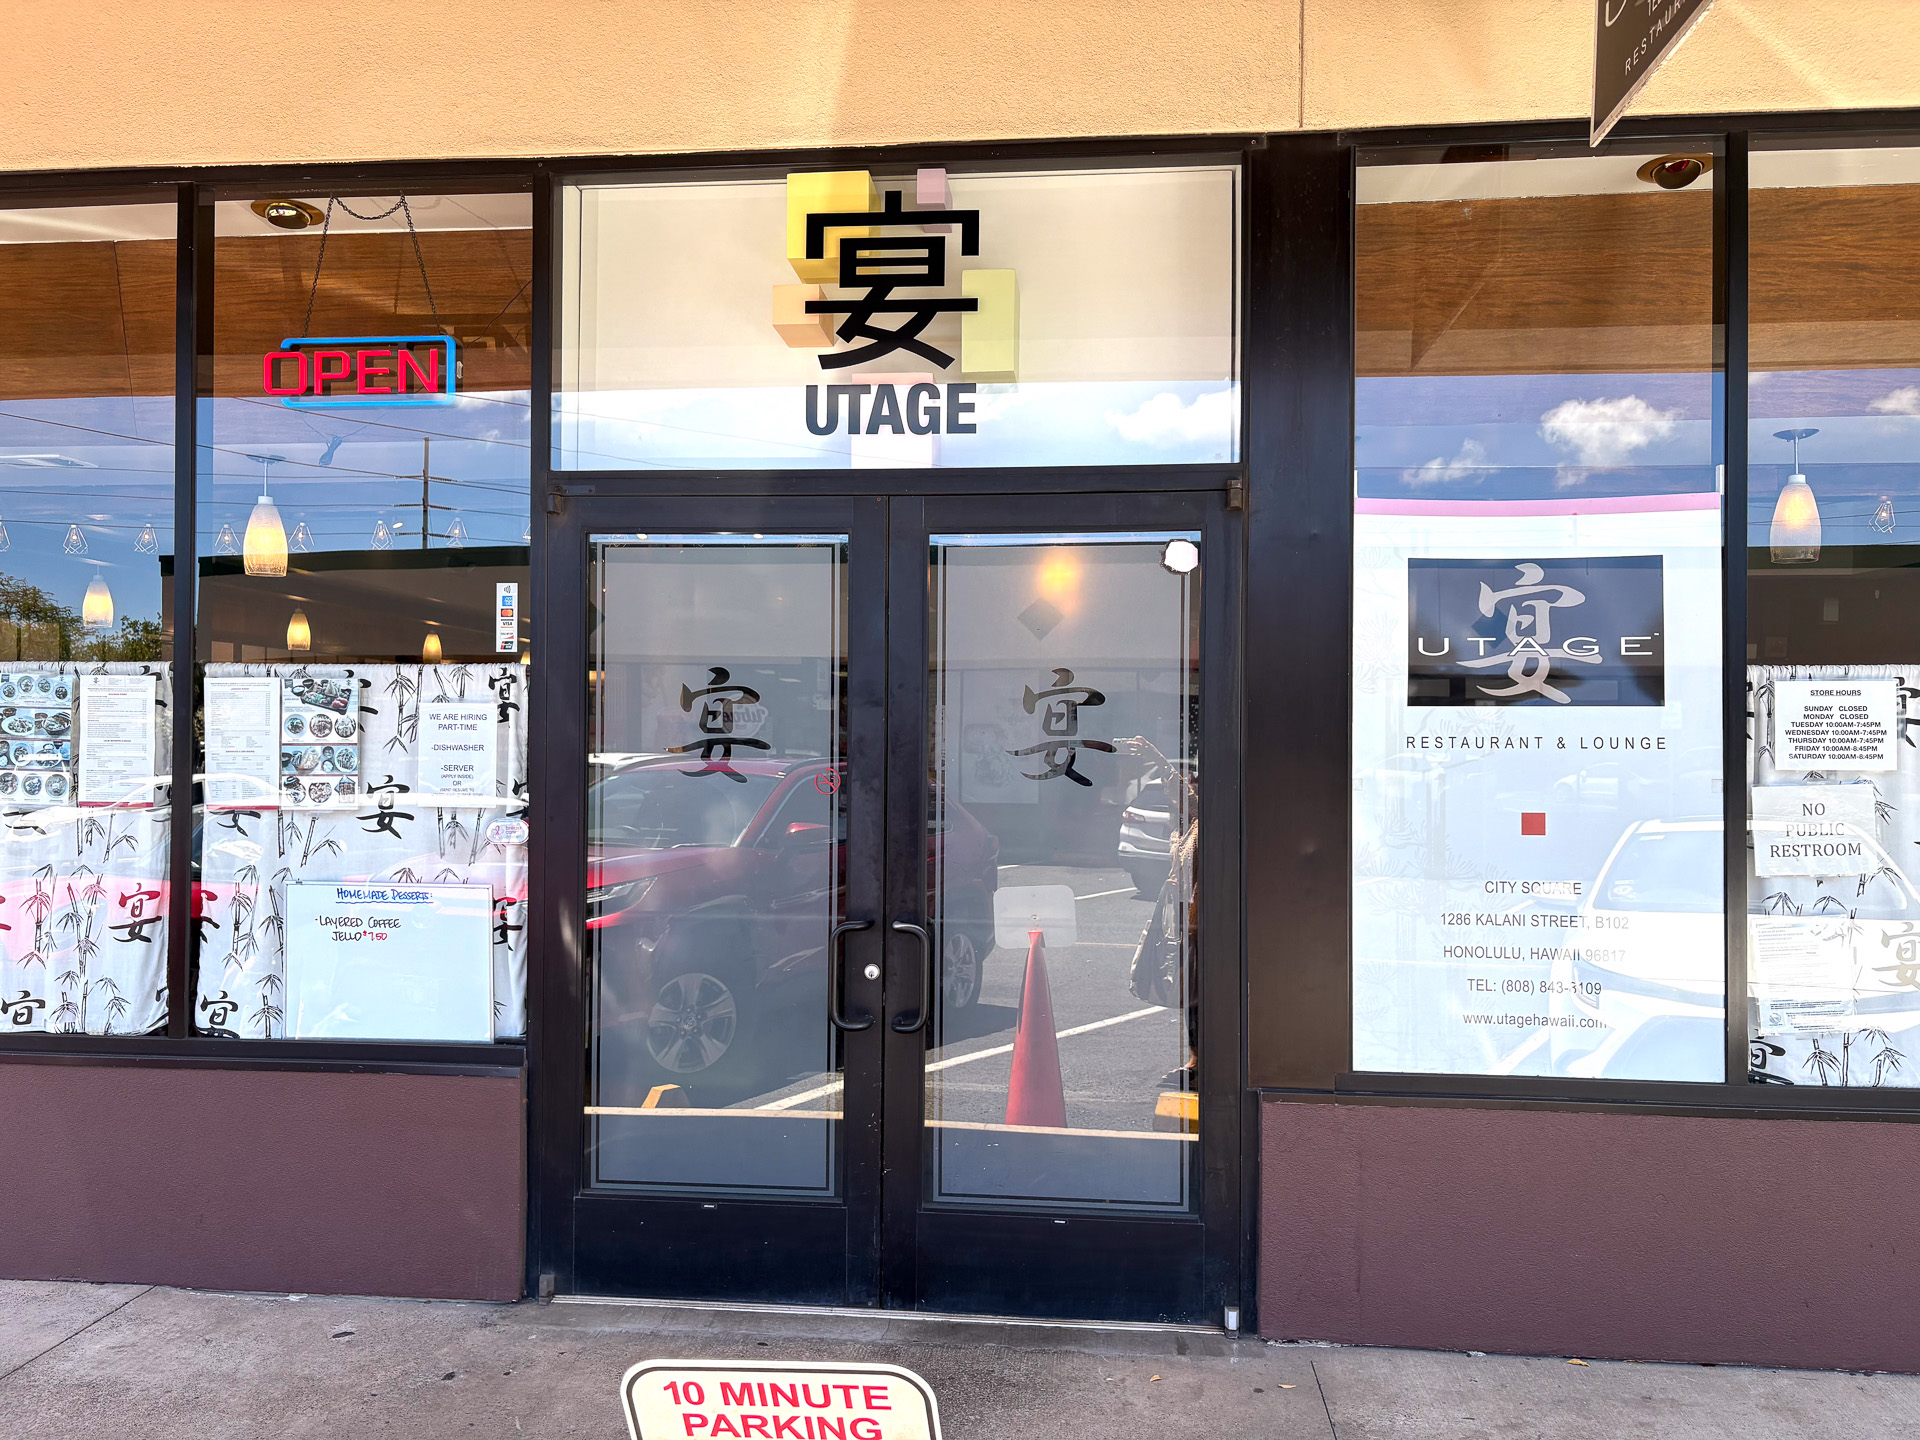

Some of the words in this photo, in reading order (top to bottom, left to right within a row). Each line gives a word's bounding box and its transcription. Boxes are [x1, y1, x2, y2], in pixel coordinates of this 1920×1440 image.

[1625, 0, 1686, 75] RESTAUR
[805, 190, 980, 370] 宴
[263, 349, 438, 396] OPEN
[806, 383, 977, 436] UTAGE
[1456, 562, 1603, 704] 宴
[429, 713, 442, 721] WE
[443, 713, 459, 721] ARE
[460, 713, 488, 721] HIRING
[663, 667, 771, 784] 宴
[1005, 668, 1117, 787] 宴
[431, 744, 485, 752] -DISHWASHER
[1406, 736, 1543, 750] RESTAURANT
[1556, 736, 1567, 750] &
[1580, 736, 1667, 750] LOUNGE
[440, 764, 475, 772] -SERVER
[1802, 802, 1826, 816] NO
[1785, 822, 1845, 837] PUBLIC
[1770, 842, 1862, 858] RESTROOM
[336, 887, 389, 900] HOMEMADE
[1485, 880, 1517, 894] CITY
[1521, 881, 1582, 895] SQUARE
[368, 916, 402, 929] COFFEE
[1440, 912, 1471, 926] 1286
[1475, 913, 1526, 927] KALANI
[1530, 914, 1590, 930] STREET,
[1595, 916, 1630, 929] B102
[331, 931, 362, 941] JELLO
[1443, 946, 1525, 961] HONOLULU,
[1530, 947, 1580, 961] HAWAII
[1585, 949, 1626, 962] 96817
[1467, 978, 1497, 992] TEL:
[1501, 979, 1535, 995] (808)
[1463, 1013, 1608, 1028] www.utagehawaii.com
[663, 1380, 705, 1406] 10
[719, 1381, 892, 1411] MINUTE
[682, 1413, 883, 1440] PARKING
